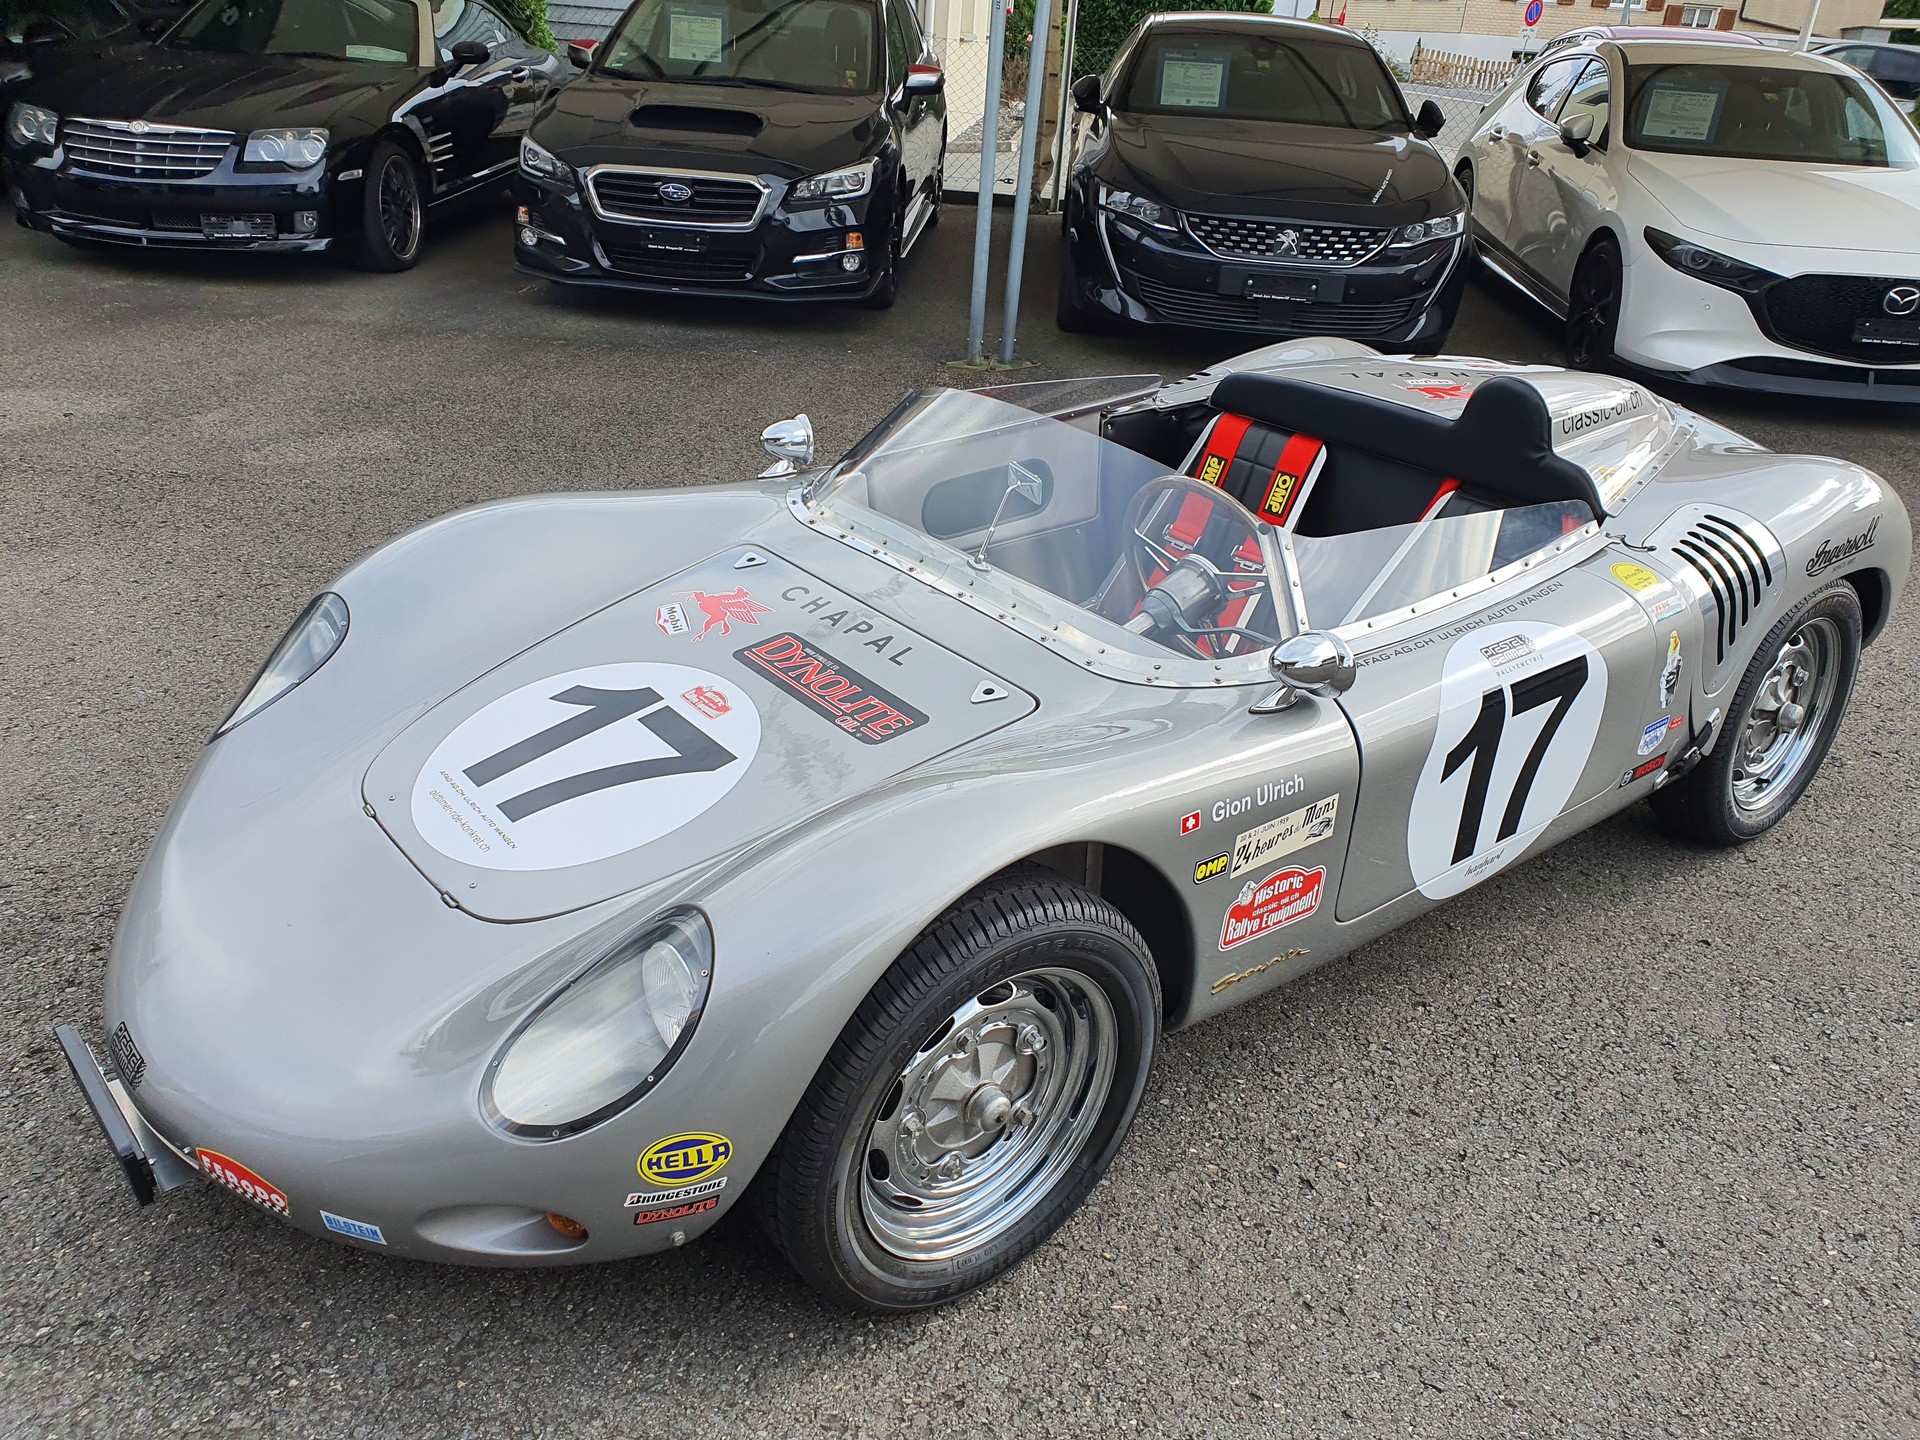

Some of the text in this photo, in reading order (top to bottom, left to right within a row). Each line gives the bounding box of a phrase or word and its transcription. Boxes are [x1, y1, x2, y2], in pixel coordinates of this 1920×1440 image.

[1203, 456, 1222, 485] MP
[1269, 475, 1291, 513] OMP
[1806, 515, 1881, 577] Ingersoll
[665, 605, 685, 633] Mobil
[781, 585, 916, 666] CHAPAL
[1356, 580, 1564, 670] AFAG-AG.CH ULRICH AUTO WANGEN
[752, 635, 913, 736] DYNOLITE
[835, 715, 857, 732] OIL
[462, 684, 738, 823] 17
[1440, 654, 1589, 866] 17
[1635, 754, 1667, 778] BOSCH
[1211, 773, 1305, 822] Gion Ulrich
[480, 813, 497, 828] AUTO
[494, 826, 518, 849] WANGEN
[1232, 798, 1336, 873] 24 heures du Mans
[1239, 833, 1247, 842] 20
[1260, 823, 1276, 835] JUIN
[1196, 857, 1228, 880] OMP
[1251, 893, 1300, 917] classic-oil.ch
[1253, 874, 1304, 908] Historic
[1226, 885, 1319, 942] Rallye Equipment
[647, 1142, 731, 1171] HELLA
[201, 1154, 286, 1208] FERODO
[629, 1178, 726, 1205] BRIDGESTONE
[324, 1215, 380, 1239] BILSTEIN
[637, 1198, 718, 1225] DYNOLITE
